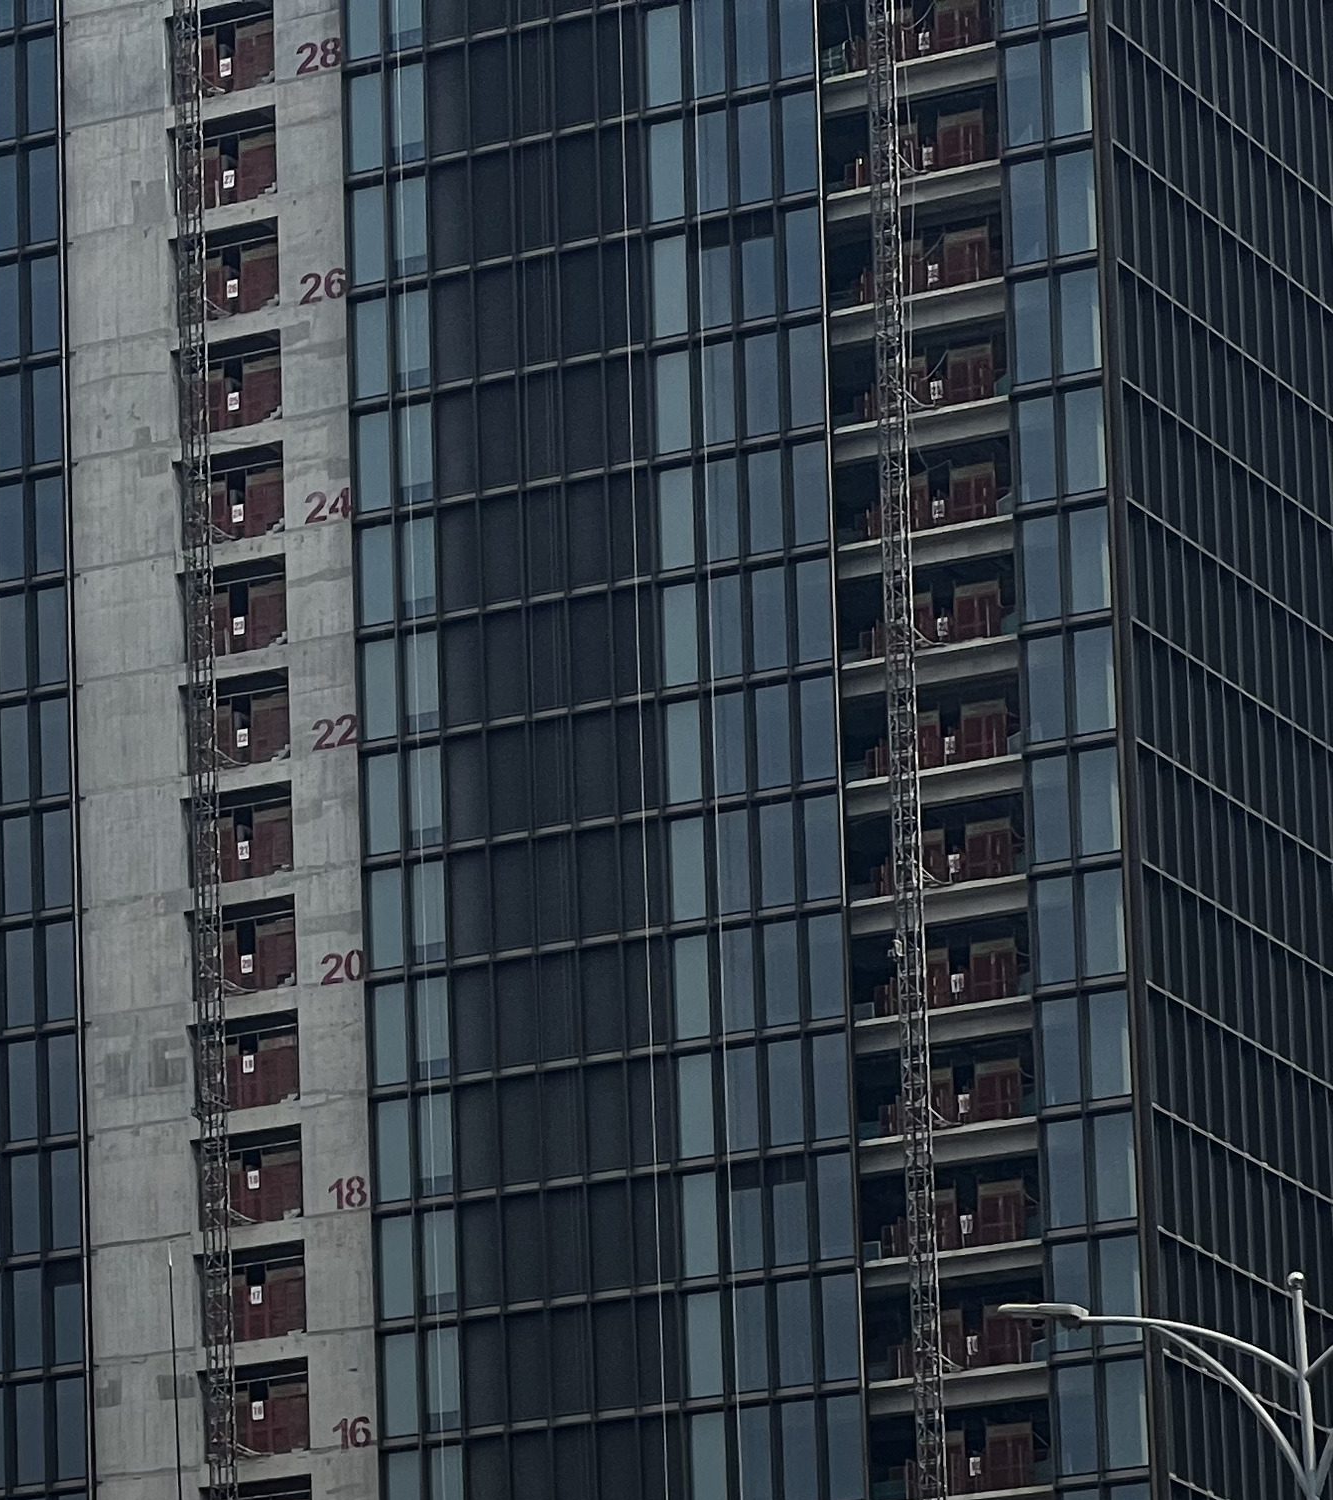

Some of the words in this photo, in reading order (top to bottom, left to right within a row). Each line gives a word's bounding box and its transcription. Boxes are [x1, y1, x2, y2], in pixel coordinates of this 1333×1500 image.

[296, 37, 341, 76] 28
[299, 267, 346, 306] 26
[304, 486, 351, 525] 24
[311, 713, 357, 752] 22
[320, 949, 364, 987] 20
[328, 1175, 367, 1210] 18
[332, 1415, 372, 1451] 16
